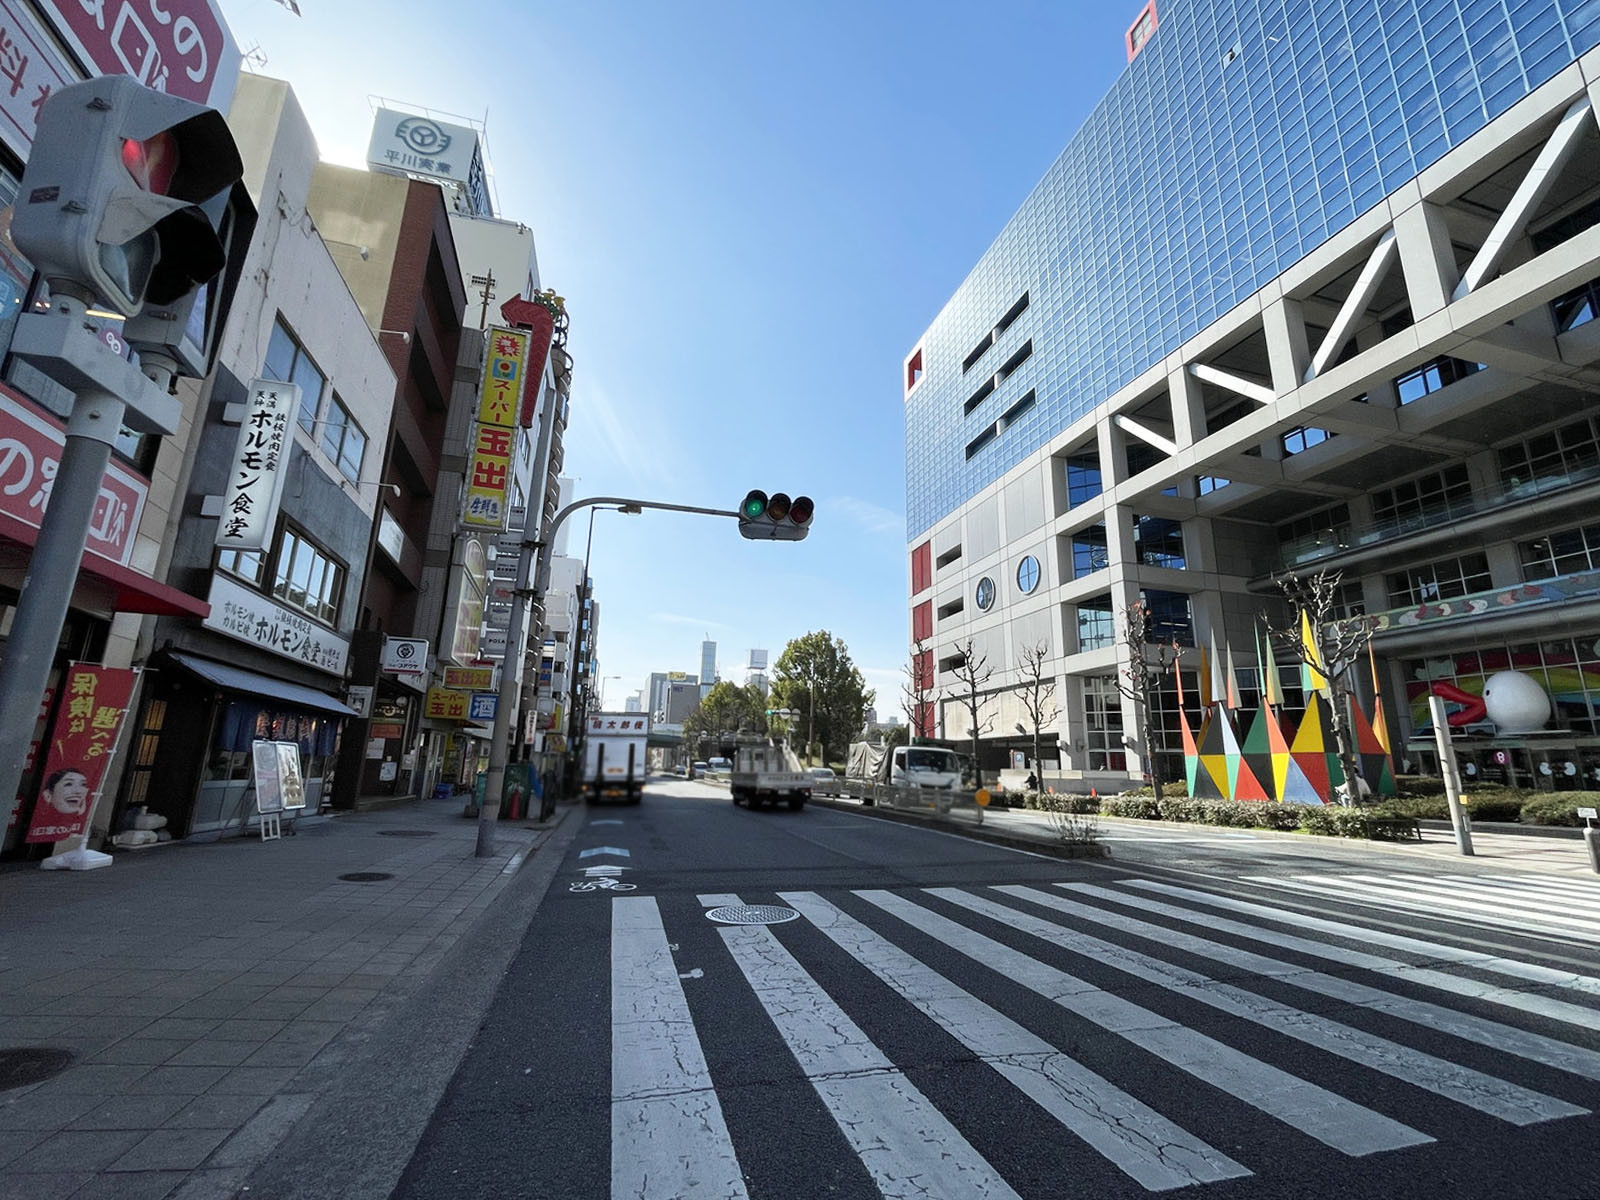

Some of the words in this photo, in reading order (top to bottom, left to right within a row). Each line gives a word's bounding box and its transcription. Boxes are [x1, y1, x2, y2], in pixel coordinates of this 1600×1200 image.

[384, 149, 452, 174] 平川実業
[490, 379, 512, 423] スーパー
[224, 409, 273, 539] ホルモン食堂
[473, 428, 511, 490] 玉出
[254, 616, 321, 665] ホルモン食堂
[430, 702, 463, 716] 玉出
[432, 692, 464, 701] スーパー
[472, 697, 497, 718] 酒
